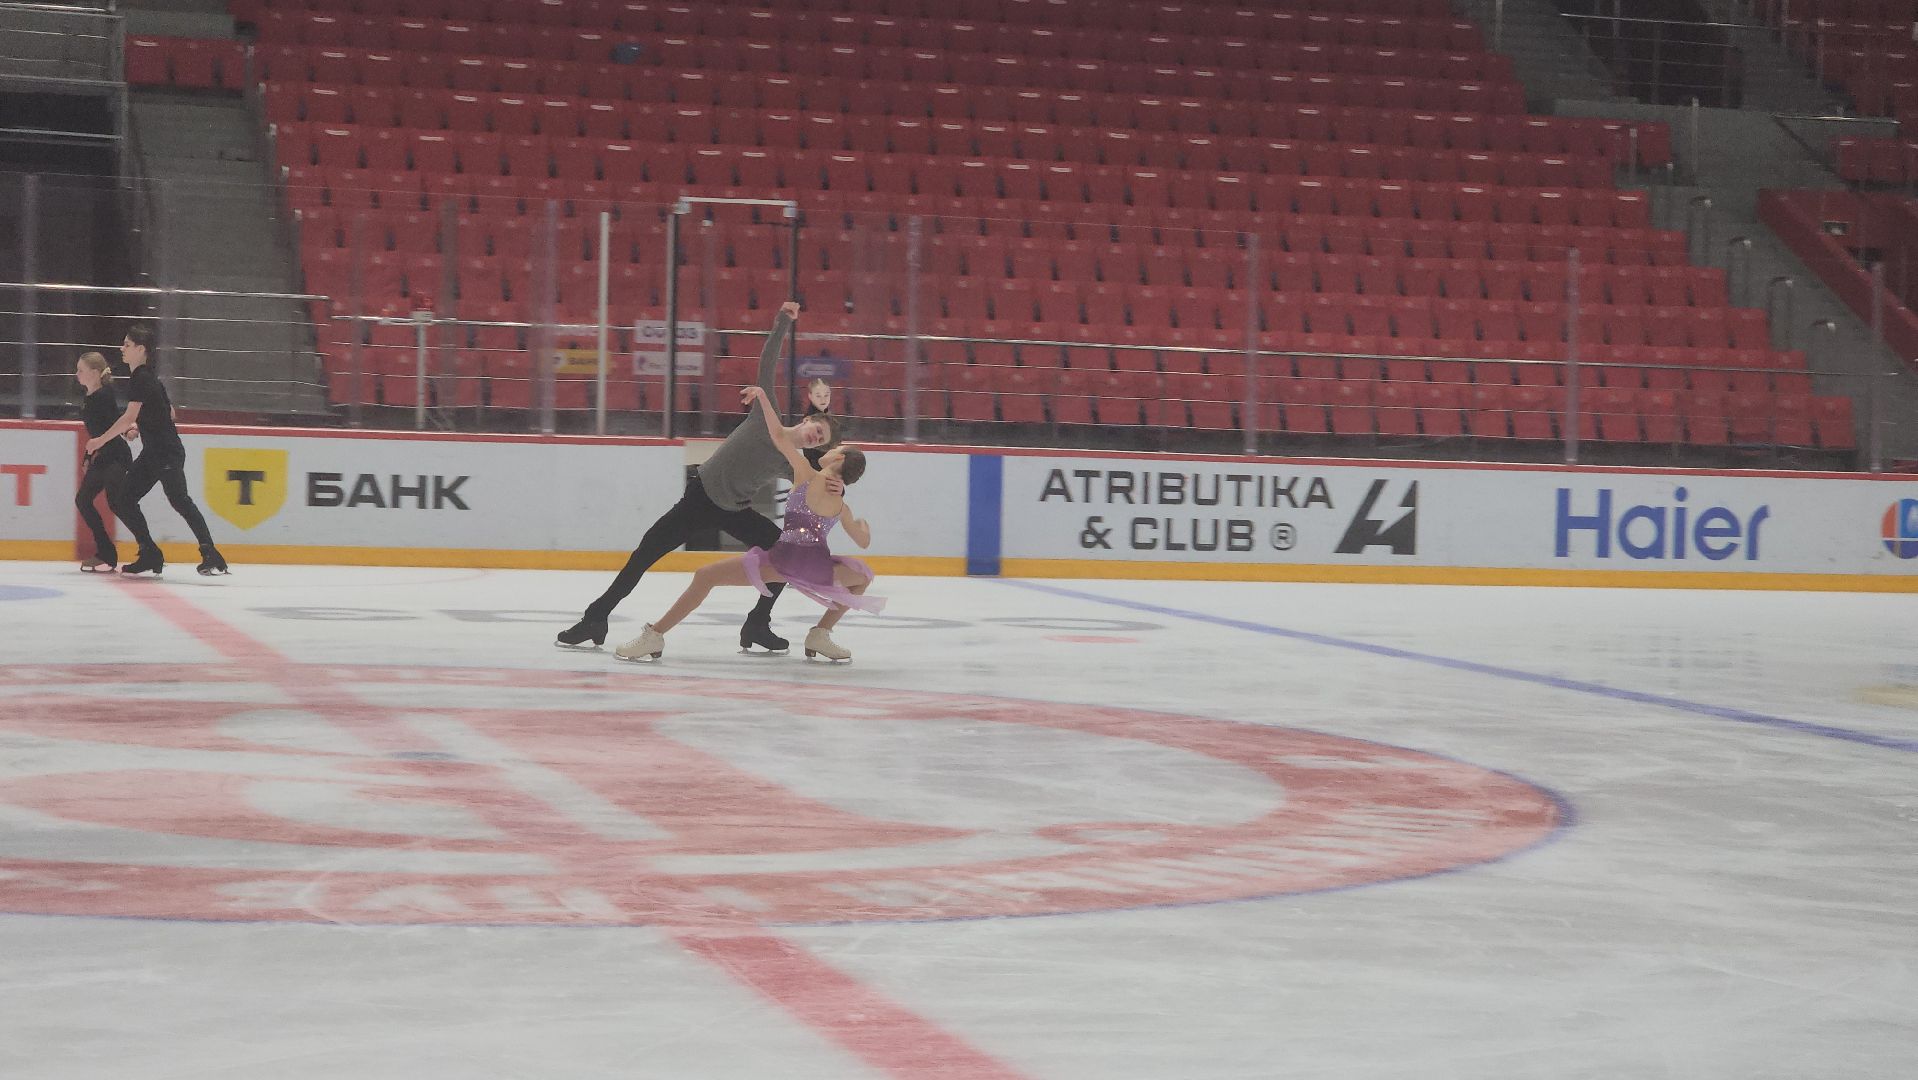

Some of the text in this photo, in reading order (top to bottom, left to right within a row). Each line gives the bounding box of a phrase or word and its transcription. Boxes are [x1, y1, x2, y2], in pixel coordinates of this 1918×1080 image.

[306, 471, 471, 511] БАНК
[1040, 468, 1335, 509] ATRIBUTIKA
[1080, 515, 1112, 550] &
[1131, 517, 1254, 552] CLUB
[1554, 486, 1771, 561] Haier
